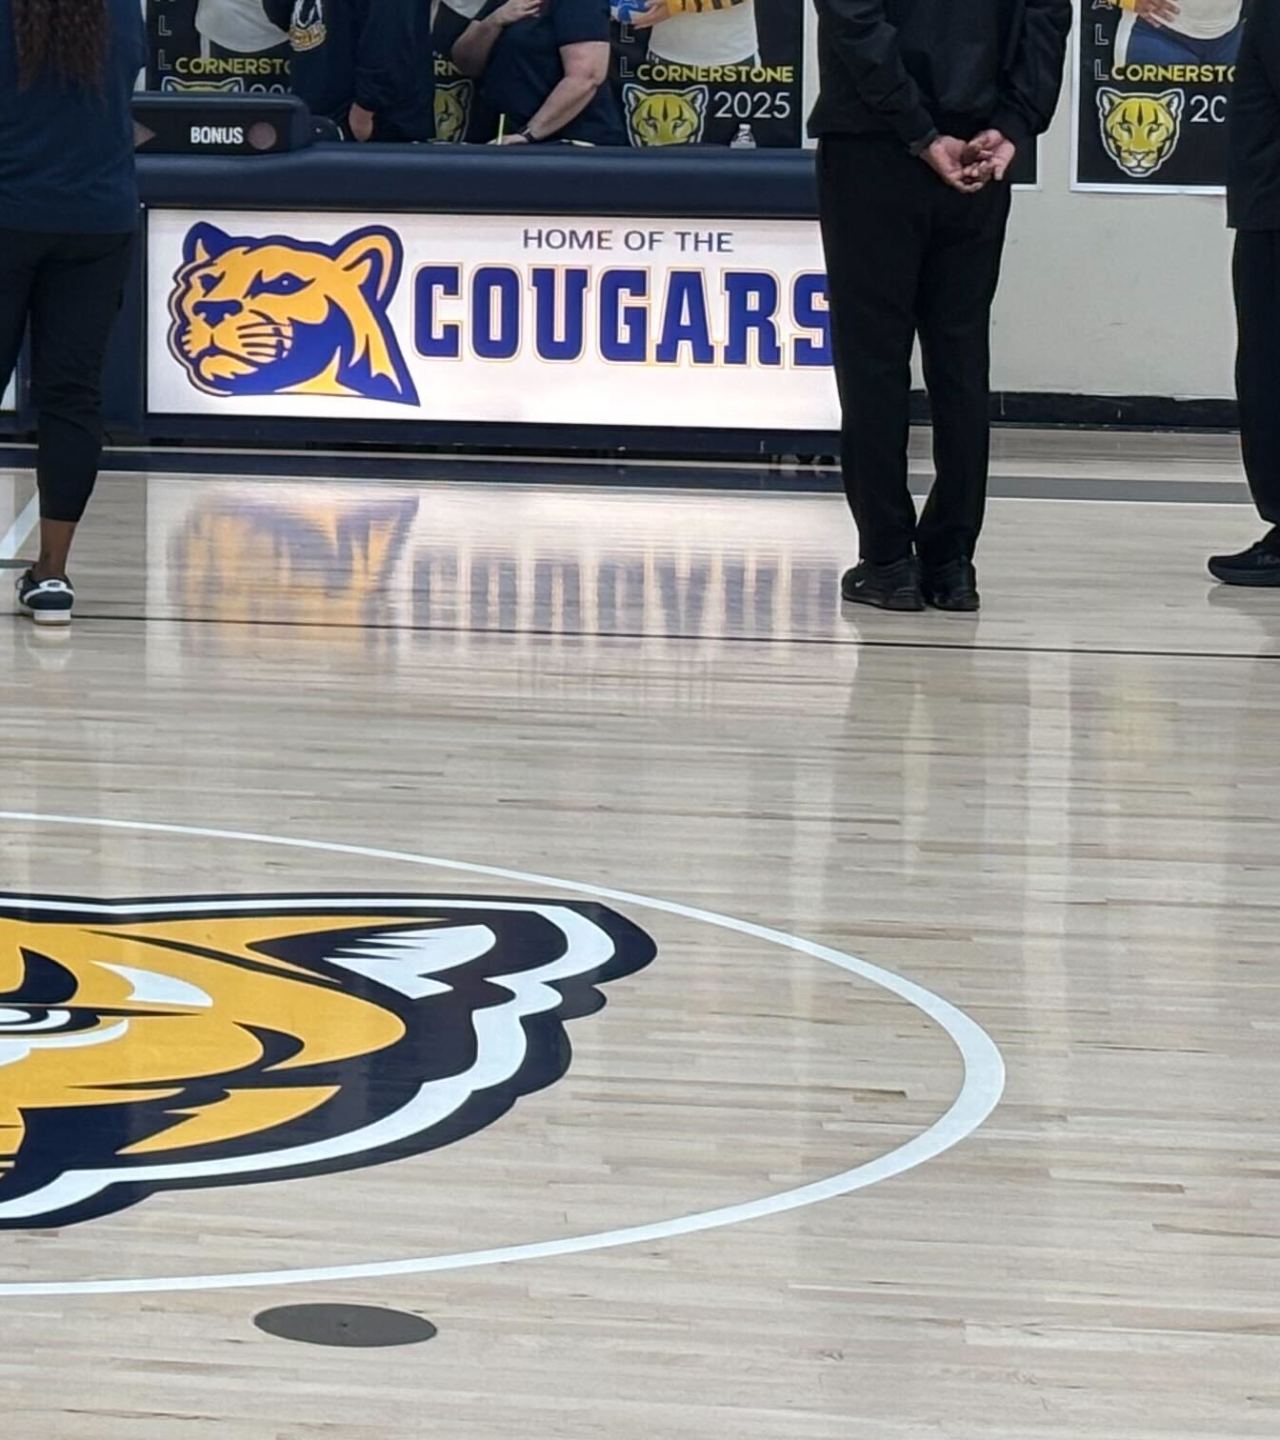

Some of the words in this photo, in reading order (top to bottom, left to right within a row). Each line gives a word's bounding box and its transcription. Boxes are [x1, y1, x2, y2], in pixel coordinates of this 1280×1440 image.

[636, 65, 794, 83] CORNERSTONE
[1111, 64, 1235, 83] CORNERST
[714, 91, 791, 119] 2025
[1190, 94, 1228, 123] 20
[190, 126, 244, 145] BONUS
[522, 228, 613, 251] HOME
[623, 229, 664, 251] OF
[673, 231, 734, 254] THE
[411, 265, 836, 369] COUGARS
